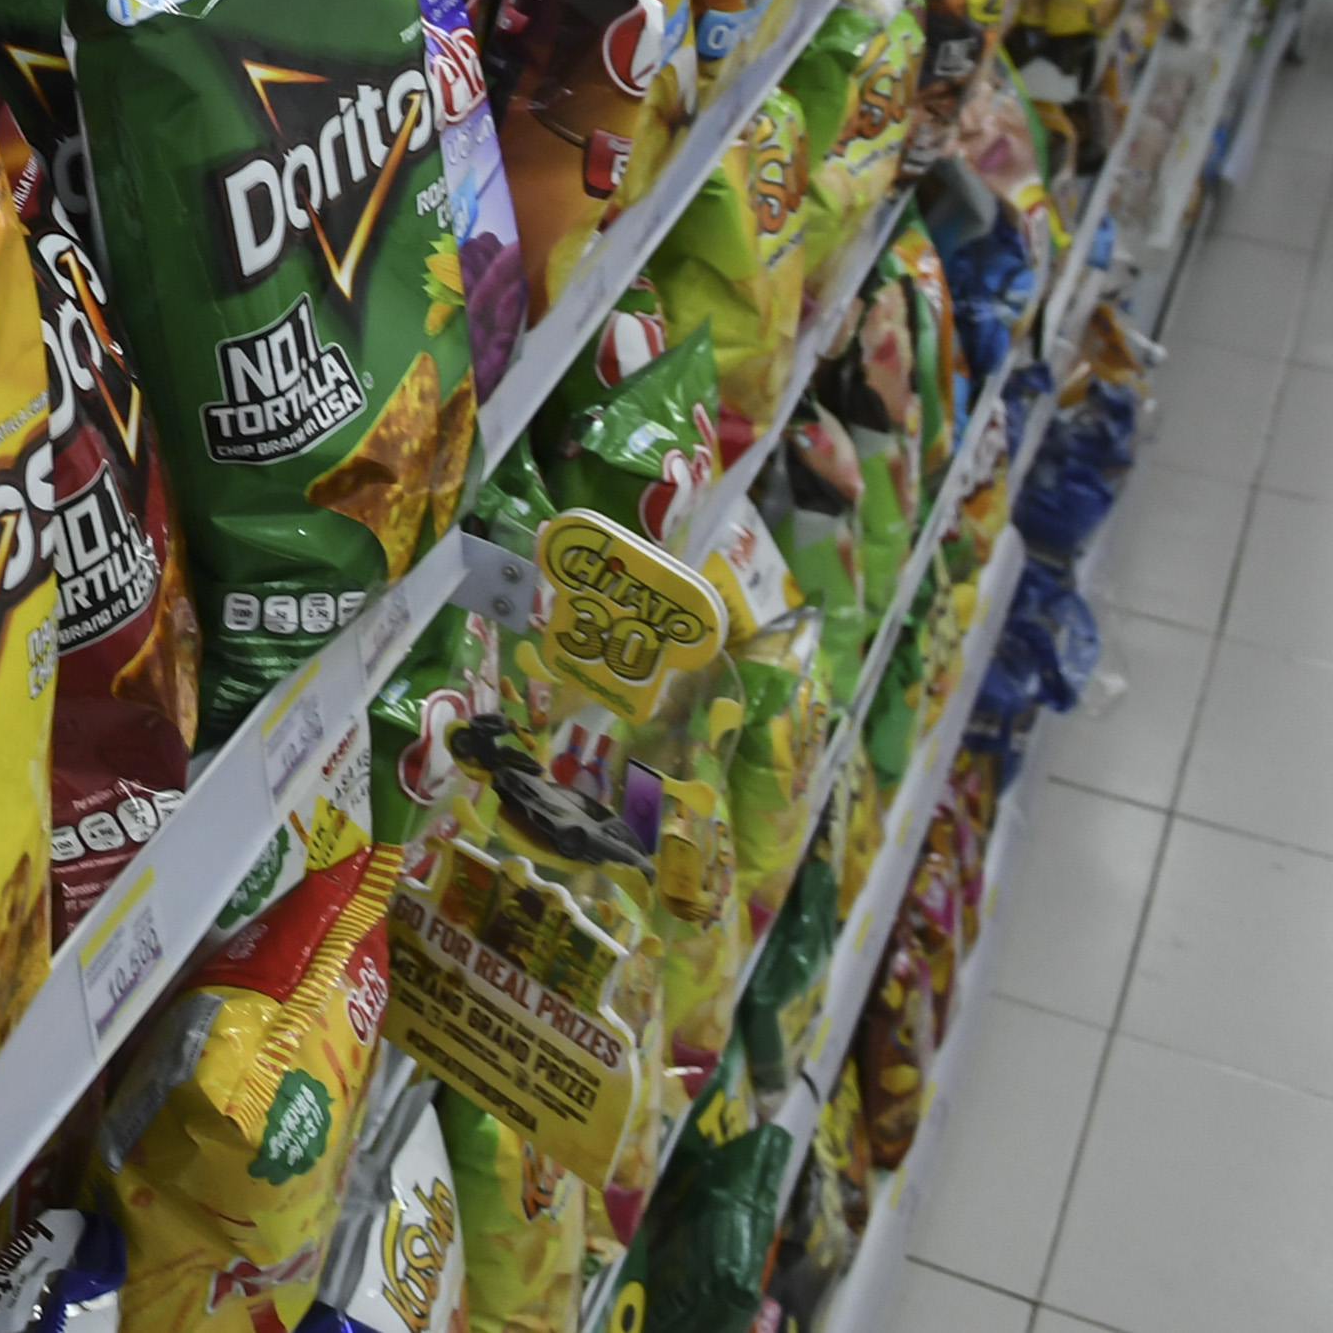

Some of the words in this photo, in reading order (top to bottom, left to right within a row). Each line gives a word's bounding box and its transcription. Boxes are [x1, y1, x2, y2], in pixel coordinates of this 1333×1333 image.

[225, 69, 433, 278] Dorito
[209, 352, 351, 438] TORTILLA
[226, 302, 321, 405] NO.1
[317, 386, 363, 430] USA
[555, 596, 662, 681] 30
[393, 892, 426, 932] GO
[427, 917, 475, 968] FOR
[474, 950, 532, 1012] REAL
[536, 990, 623, 1069] PRIZES
[467, 1006, 531, 1065] GRAND
[532, 1053, 598, 1112] PRIZE!
